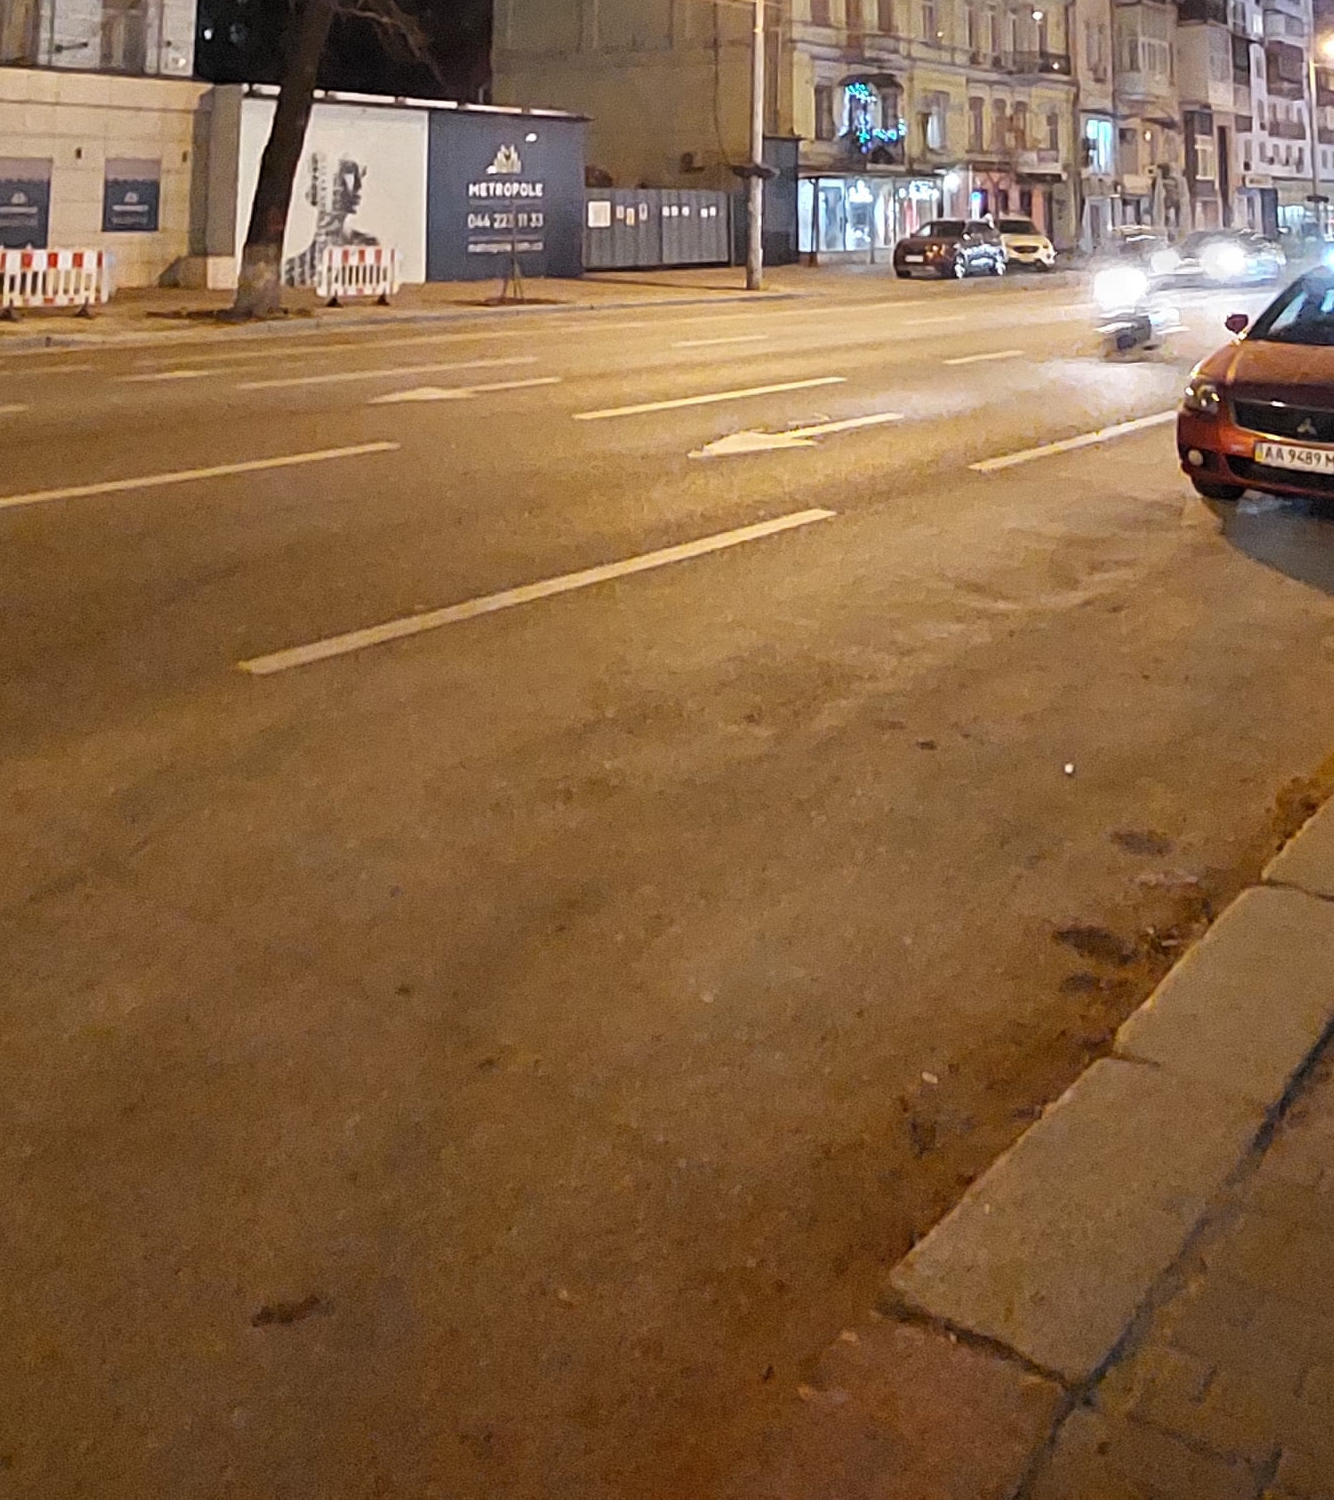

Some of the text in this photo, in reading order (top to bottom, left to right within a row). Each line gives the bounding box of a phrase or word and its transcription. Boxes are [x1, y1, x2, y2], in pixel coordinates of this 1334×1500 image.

[468, 182, 544, 198] METROPOLE
[1265, 445, 1285, 462] AA
[1288, 448, 1323, 467] 9489
